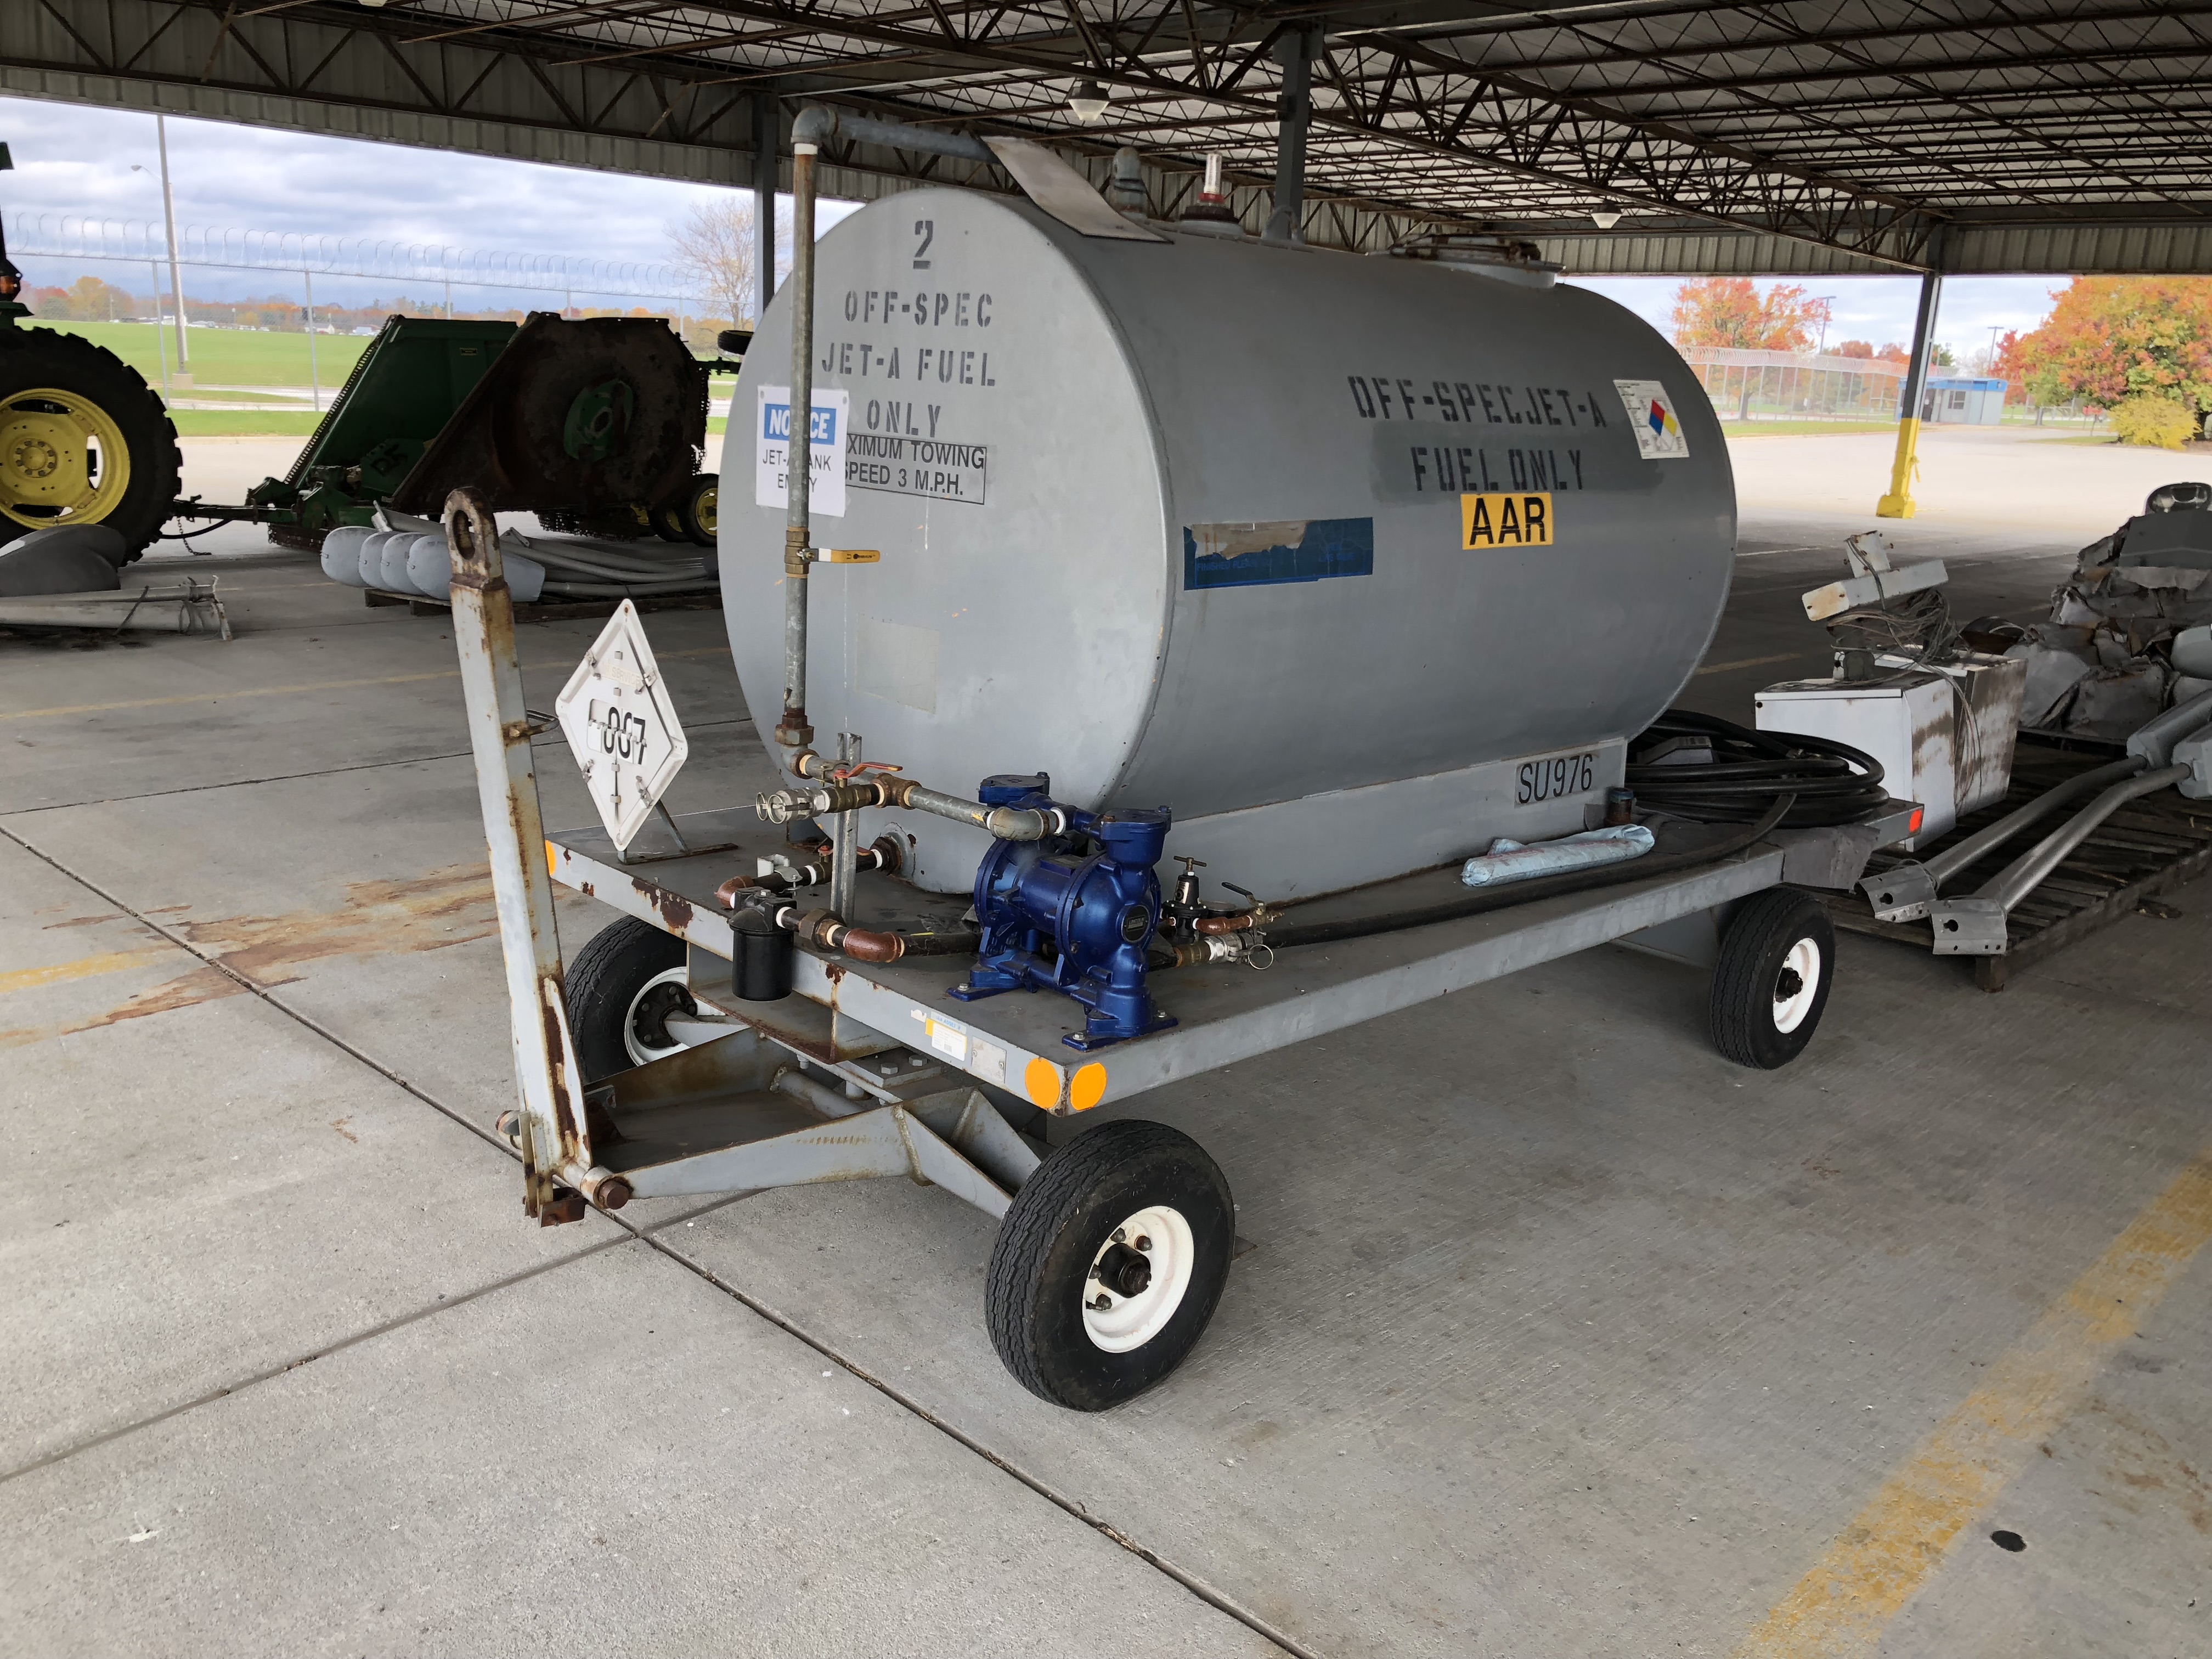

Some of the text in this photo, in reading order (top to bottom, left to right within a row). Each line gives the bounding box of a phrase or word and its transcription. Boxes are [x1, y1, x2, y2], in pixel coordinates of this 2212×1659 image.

[913, 221, 933, 269] 2
[845, 290, 992, 327] OFF-SPEC
[822, 342, 995, 386] JET-A FUEL
[769, 409, 830, 439] NOCE
[867, 399, 941, 437] ONLY
[763, 449, 831, 471] JET- ANK
[848, 435, 984, 469] XIMUM TOWING
[1410, 447, 1582, 491] FUEL ONLY
[898, 469, 907, 487] 3
[915, 470, 963, 495] M.P.H.
[1470, 497, 1545, 545] AAR
[1518, 754, 1593, 804] SU976
